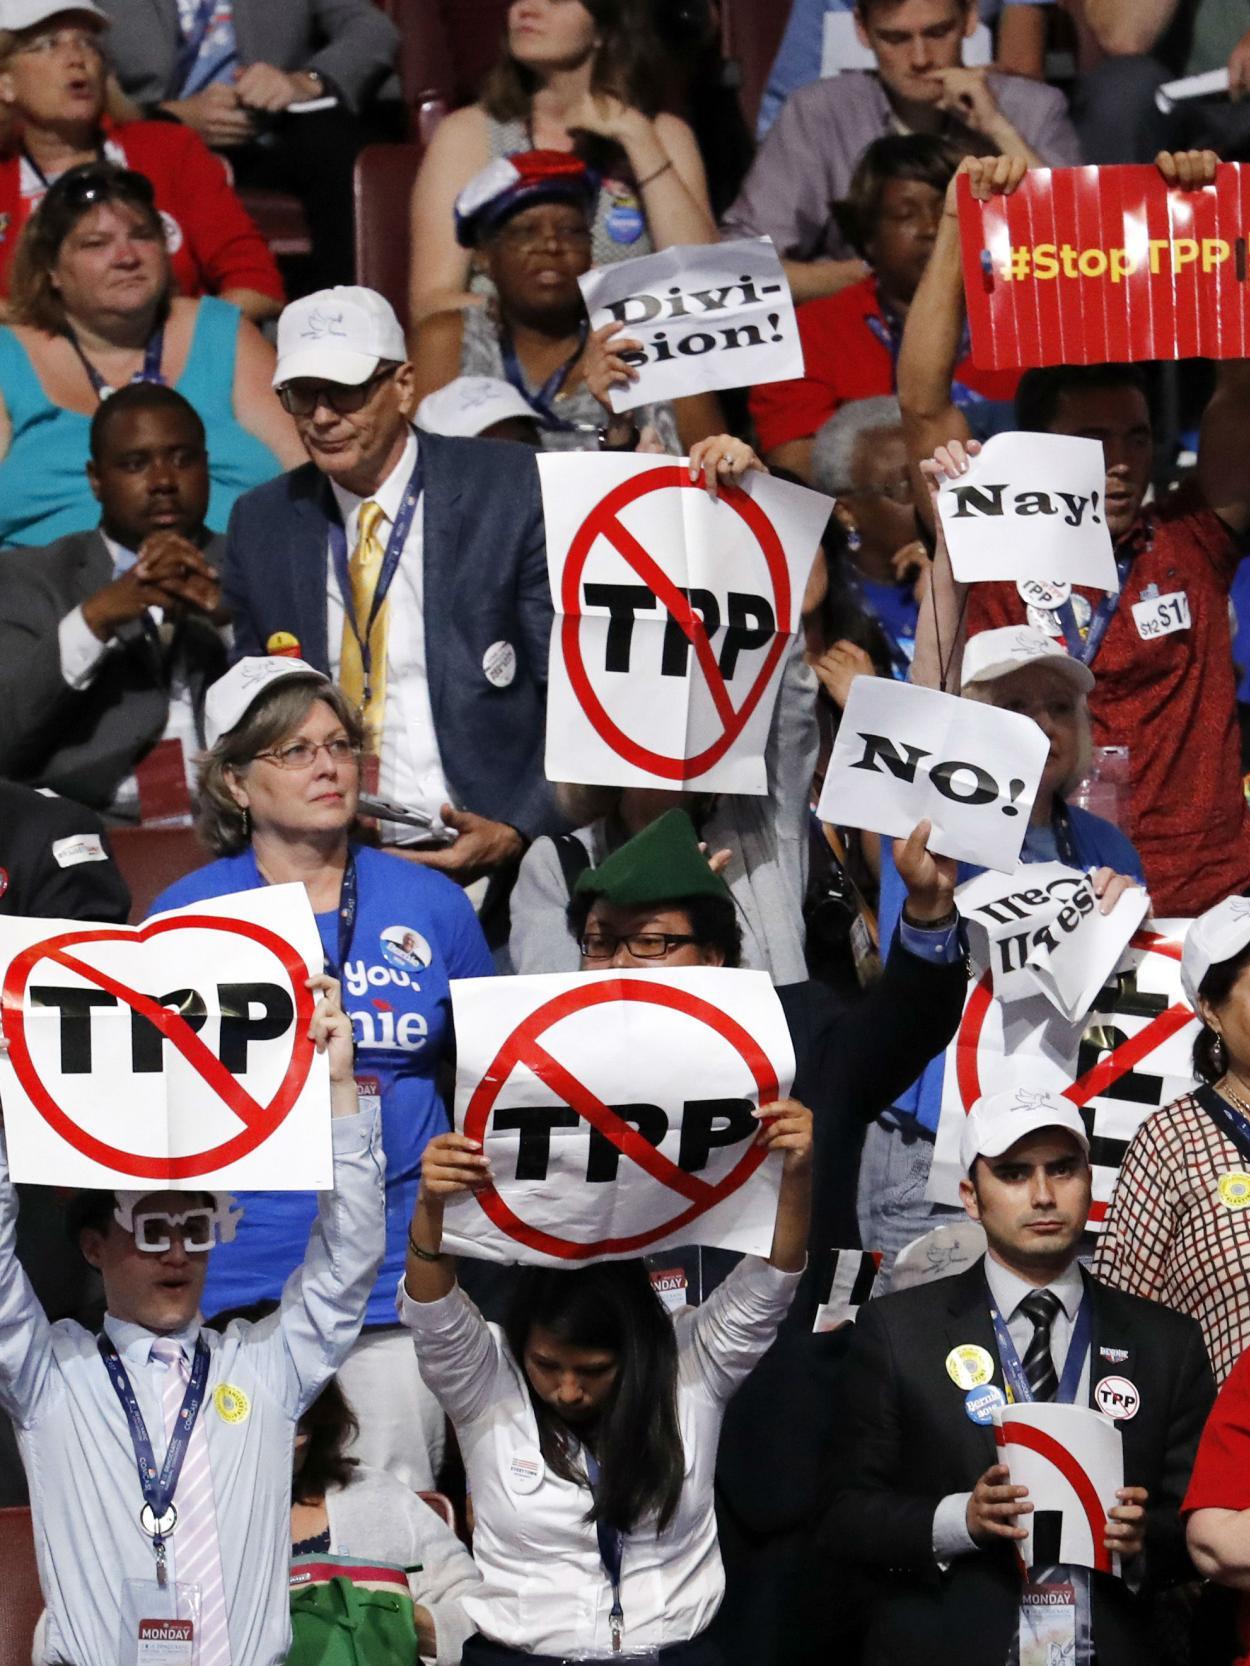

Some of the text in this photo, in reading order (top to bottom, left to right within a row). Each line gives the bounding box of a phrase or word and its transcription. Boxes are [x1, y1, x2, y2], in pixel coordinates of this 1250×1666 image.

[602, 274, 781, 326] Divi-
[948, 483, 1102, 527] Nay!
[583, 582, 776, 681] TPP
[848, 732, 1026, 817] NO!
[344, 960, 422, 997] you.
[29, 982, 295, 1075] TPP
[347, 999, 429, 1050] nie
[357, 1083, 377, 1096] DAY
[492, 1098, 761, 1183] TPP
[653, 1278, 682, 1291] NDAY
[1100, 1389, 1135, 1408] TPP
[1022, 1593, 1071, 1605] MONDAY
[142, 1628, 190, 1640] MONDAY
